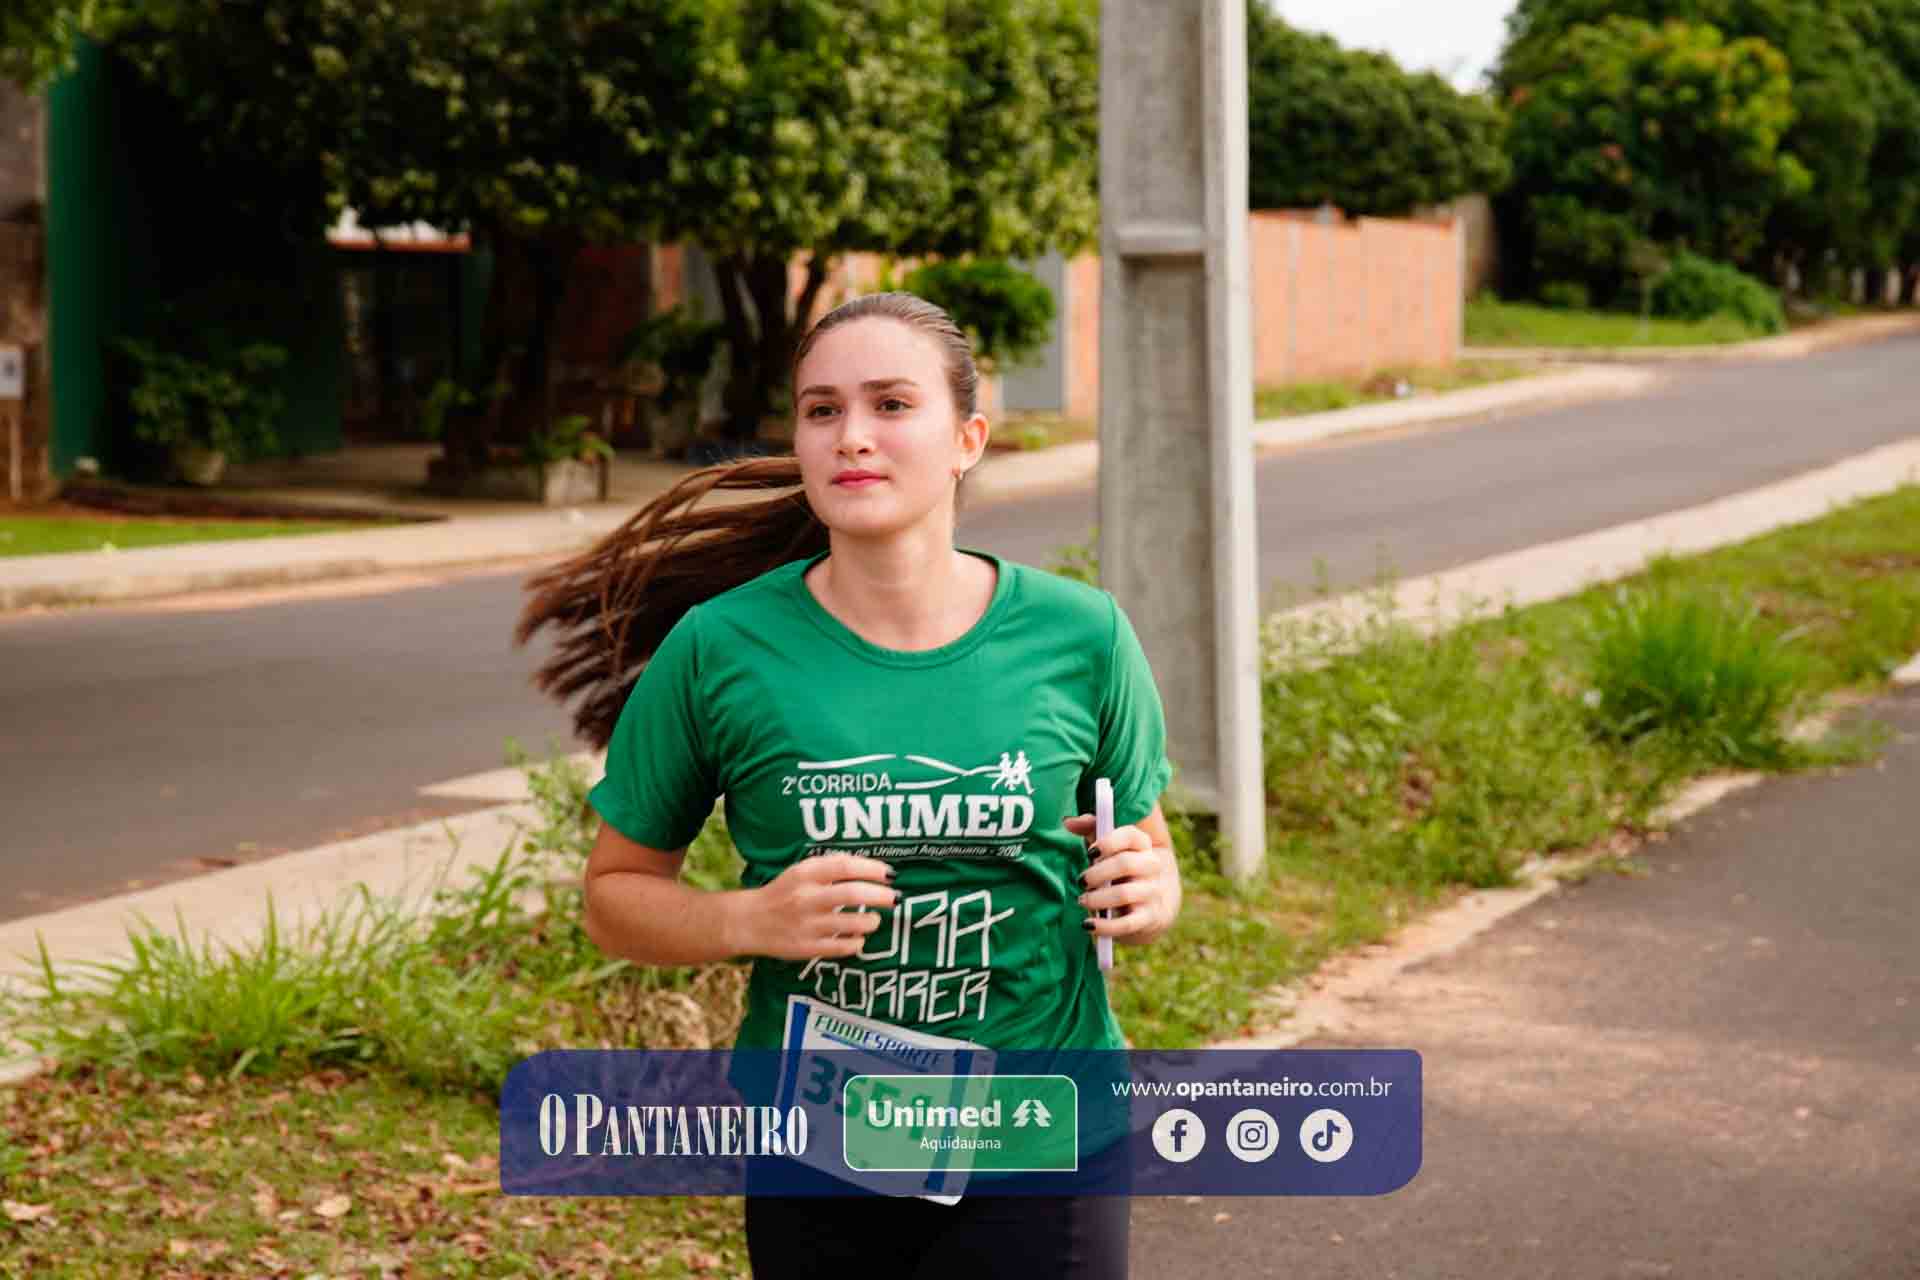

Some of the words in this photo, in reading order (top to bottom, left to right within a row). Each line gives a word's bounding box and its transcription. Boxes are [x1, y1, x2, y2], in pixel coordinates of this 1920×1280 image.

[798, 772, 892, 794] CORRIDA
[799, 794, 1034, 841] UNIMED
[832, 890, 1014, 968] ORA
[815, 961, 991, 1023] CORRER
